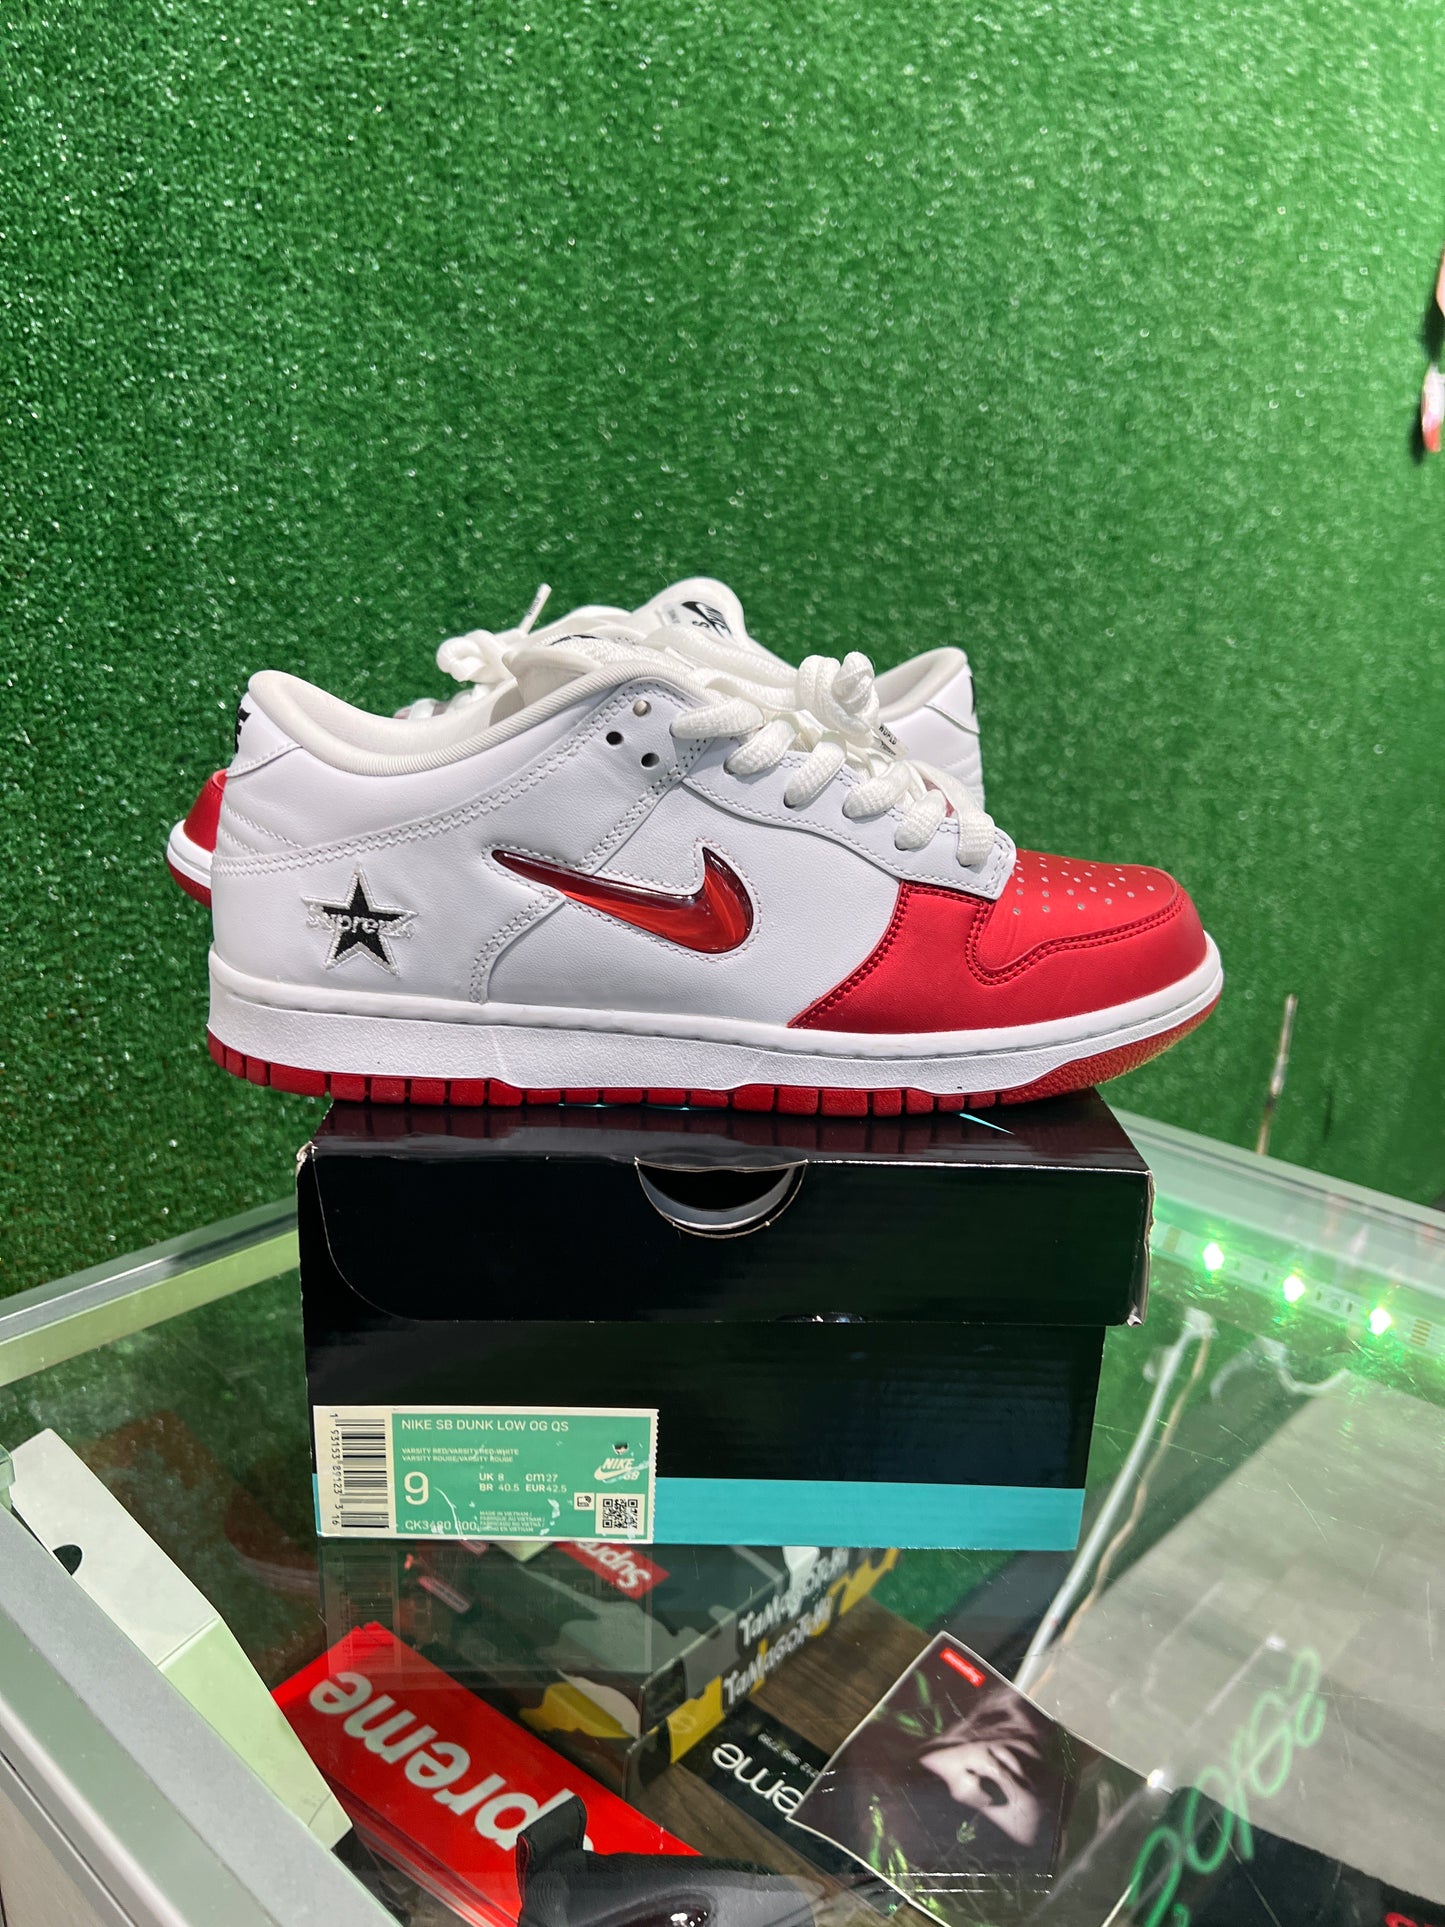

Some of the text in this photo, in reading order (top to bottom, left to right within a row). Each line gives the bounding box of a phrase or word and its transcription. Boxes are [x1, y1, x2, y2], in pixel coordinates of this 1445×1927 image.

[401, 1419, 569, 1433] NIKE SB DUNK LOW OG QS
[331, 1430, 341, 1460] 93153
[401, 1447, 431, 1455] VARSITY
[402, 1455, 431, 1463] VARSITY
[602, 1458, 635, 1470] NIKE
[332, 1465, 342, 1495] 89123
[479, 1472, 504, 1483] UK 8
[525, 1473, 558, 1483] cm 27
[403, 1470, 430, 1506] 9
[479, 1483, 520, 1493] BR 40.5
[525, 1483, 567, 1494] EUR 42.5
[574, 1541, 652, 1590] Supre
[309, 1671, 590, 1852] preme
